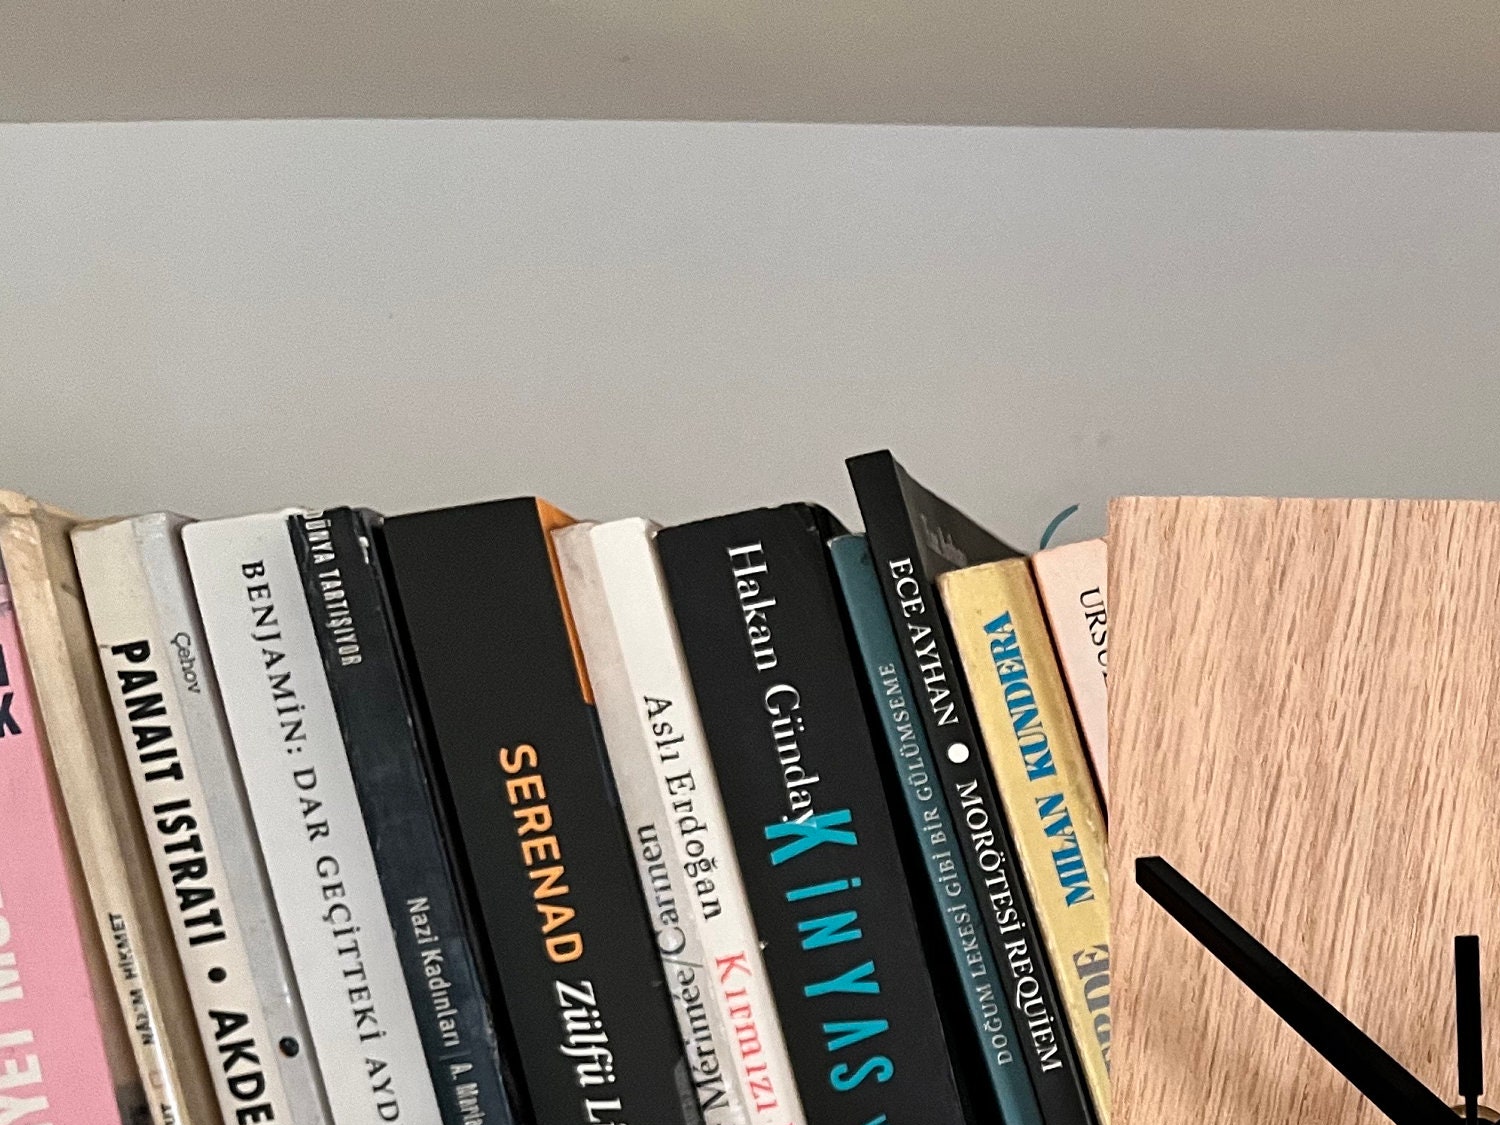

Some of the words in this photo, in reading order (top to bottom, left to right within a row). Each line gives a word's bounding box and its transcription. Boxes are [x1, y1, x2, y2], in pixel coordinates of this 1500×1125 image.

[727, 541, 778, 673] Hakan
[879, 662, 932, 802] GÜLÜMSEME
[889, 558, 925, 618] ECE
[908, 621, 958, 726] AYHAN
[956, 779, 1023, 934] MORÖTESİ
[984, 610, 1057, 782] KUNDERA
[111, 639, 184, 781] PANAIT
[154, 799, 226, 946] ISTRATI
[926, 805, 942, 844] BİR
[1036, 793, 1095, 906] MILAN
[292, 767, 330, 843] DAR
[316, 855, 385, 1044] GEÇİTTEKİ
[406, 897, 442, 945] Nazi
[500, 743, 584, 964] SERENAD
[553, 981, 617, 1088] Zülfü
[644, 696, 683, 762] Aslı
[666, 769, 724, 921] Erdoğan
[714, 950, 777, 1113] Kırmızı
[934, 852, 960, 897] GİBİ
[949, 904, 988, 981] LEKESİ
[976, 982, 1013, 1065] DOĞUM
